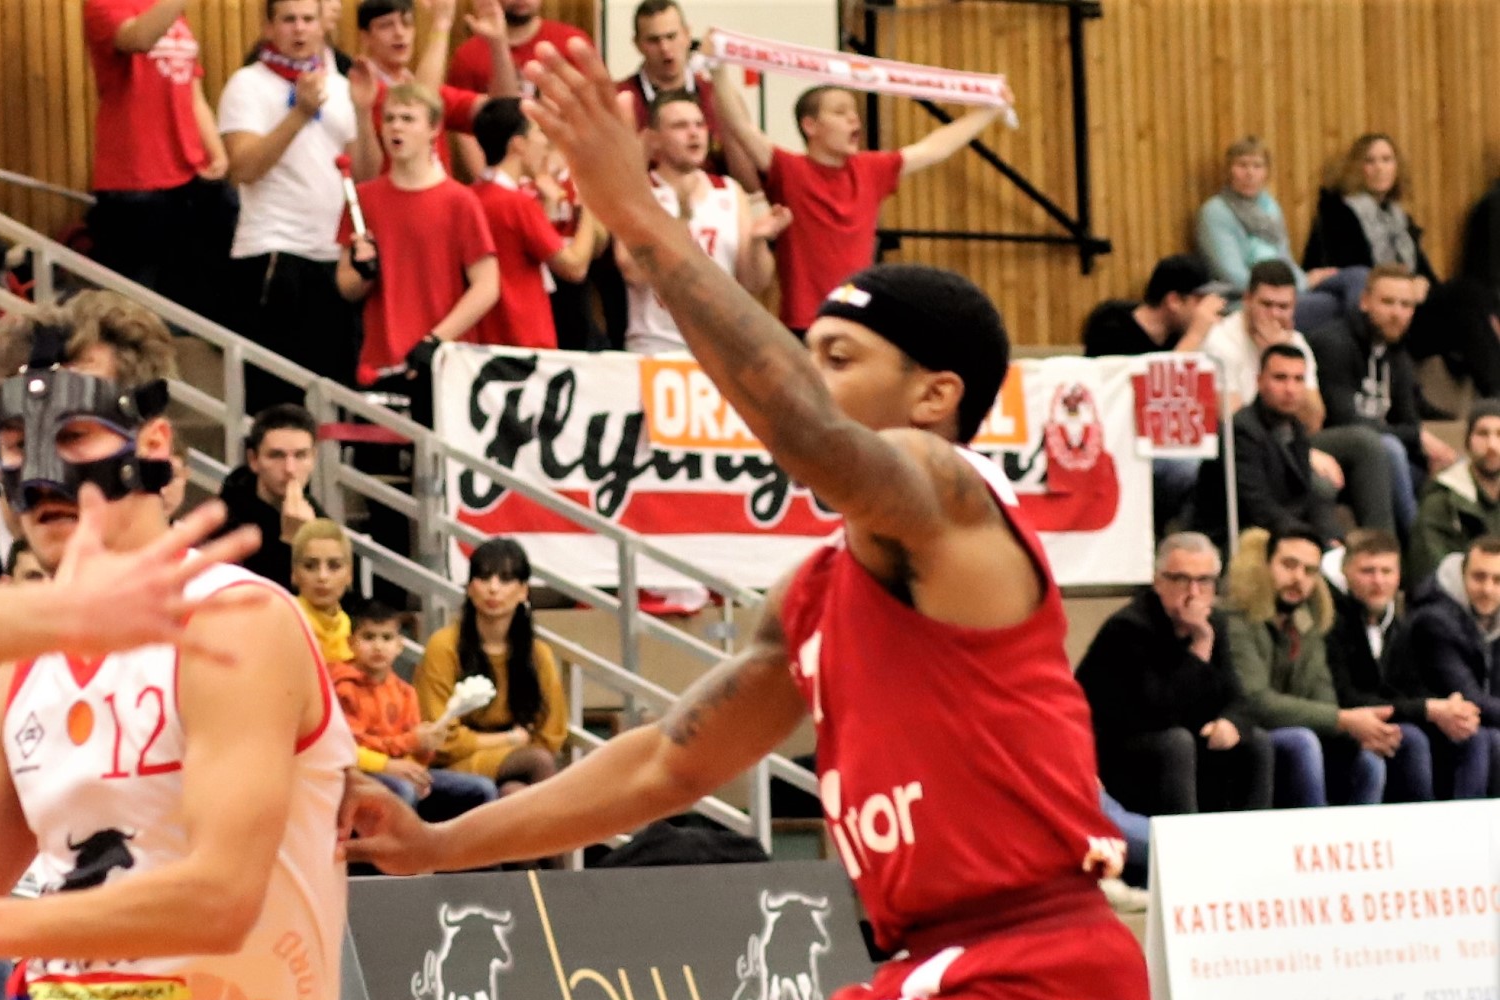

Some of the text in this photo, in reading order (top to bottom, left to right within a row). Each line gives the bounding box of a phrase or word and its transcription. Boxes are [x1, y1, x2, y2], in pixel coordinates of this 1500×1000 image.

[100, 685, 182, 780] 12
[1294, 840, 1395, 874] KANZLEI
[1173, 896, 1333, 935] KATENBRINK
[1340, 893, 1357, 924] &
